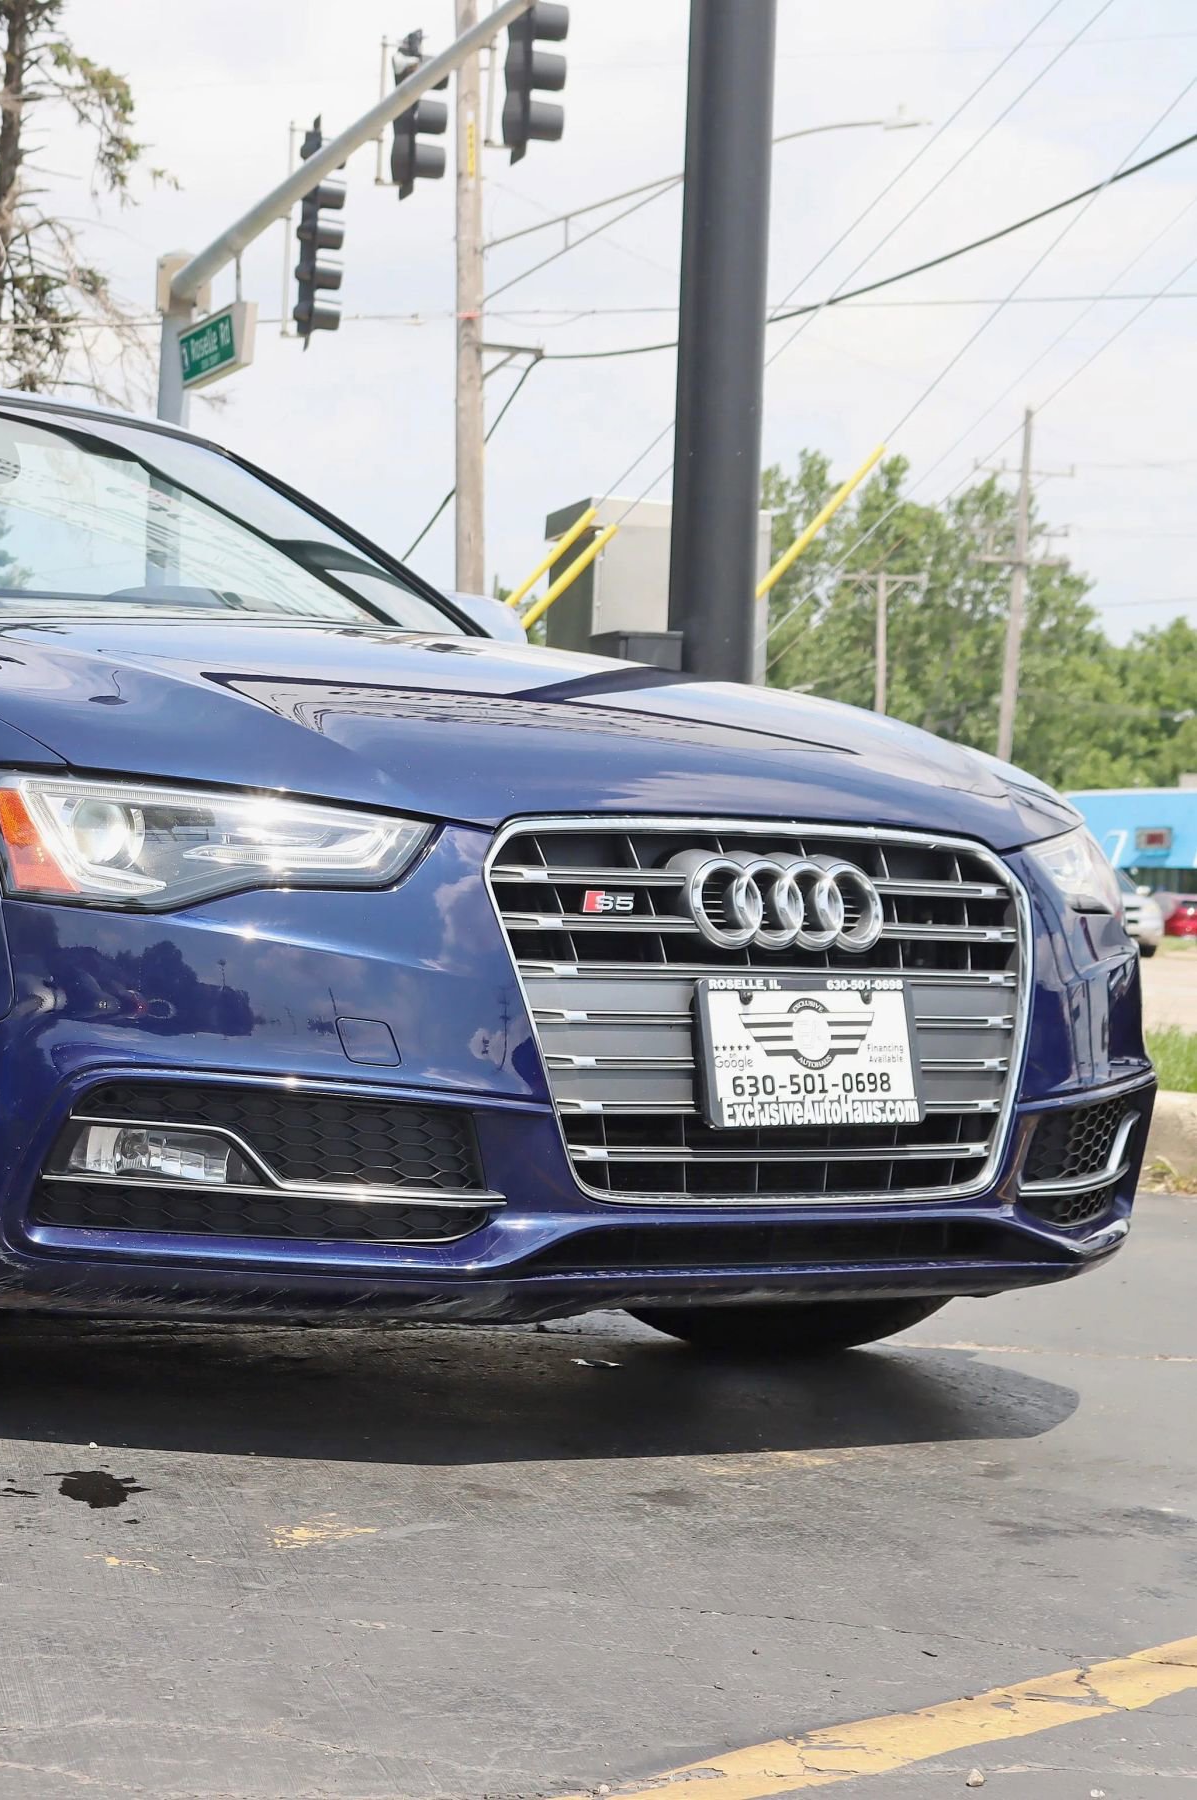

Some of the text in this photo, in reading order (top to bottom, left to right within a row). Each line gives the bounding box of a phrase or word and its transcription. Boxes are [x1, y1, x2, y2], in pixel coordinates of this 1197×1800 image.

[594, 895, 634, 911] S5
[708, 979, 782, 991] ROSELLE, IL
[826, 979, 904, 991] 630-501-0698
[792, 1000, 824, 1013] EXCLUSIVE
[714, 1055, 753, 1071] Google
[798, 1054, 833, 1068] AUTOHAUS
[732, 1072, 892, 1096] 630-501-0698
[723, 1093, 920, 1127] ExclusiveAutoHaus.com
